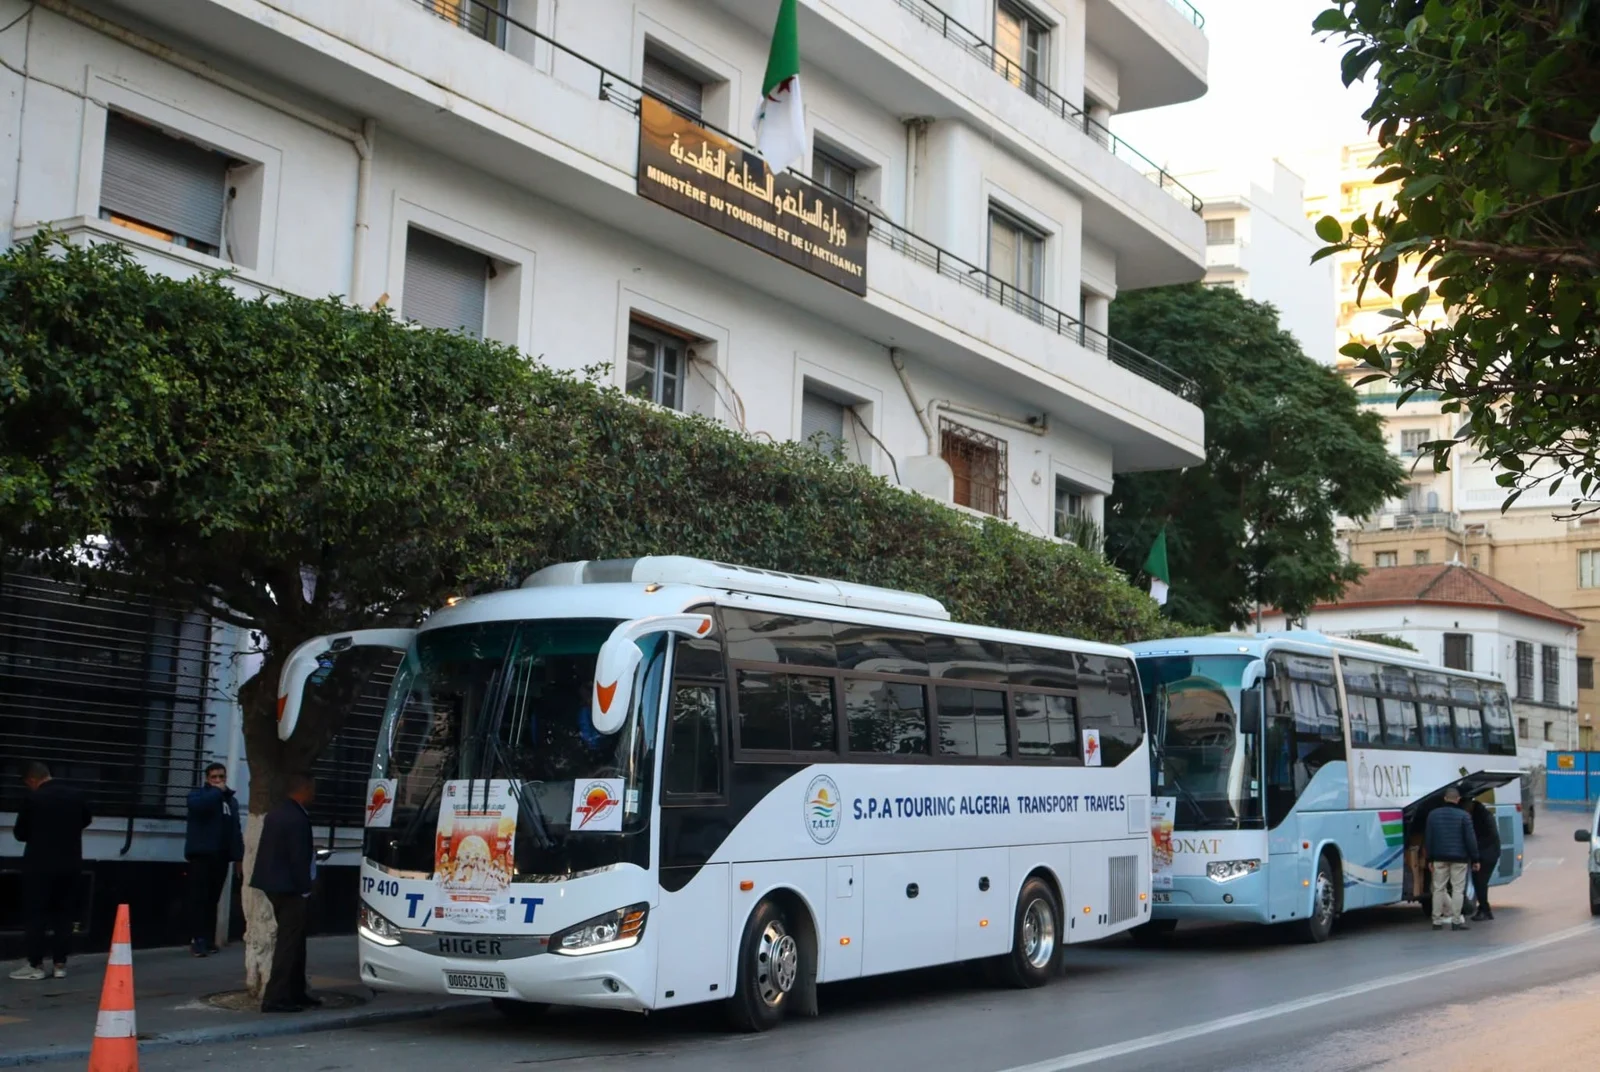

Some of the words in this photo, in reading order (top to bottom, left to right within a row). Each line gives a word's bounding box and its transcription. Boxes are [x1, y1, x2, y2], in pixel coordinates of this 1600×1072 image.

[670, 132, 726, 181] التقليدية
[726, 161, 774, 204] الصناعة
[647, 165, 707, 204] MINISTÈRE
[709, 195, 724, 211] DU
[725, 202, 777, 236] TOURISME
[777, 227, 790, 243] ET
[791, 234, 804, 250] DE
[804, 240, 862, 277] L'ARTISANAT
[782, 188, 823, 229] السياحة
[823, 207, 847, 247] وزارة
[1373, 764, 1411, 798] ONAT
[853, 797, 892, 820] S.P.A
[895, 796, 955, 818] TOURING
[960, 795, 1010, 815] ALGERIA
[1017, 795, 1079, 814] TRANSPORT
[1084, 794, 1125, 812] TRAVELS
[1171, 838, 1222, 855] ONAT
[362, 876, 375, 893] TP
[377, 879, 399, 897] 410
[439, 938, 502, 956] HIGER
[448, 974, 478, 989] 000523
[479, 976, 494, 990] 424
[496, 977, 506, 991] 16
